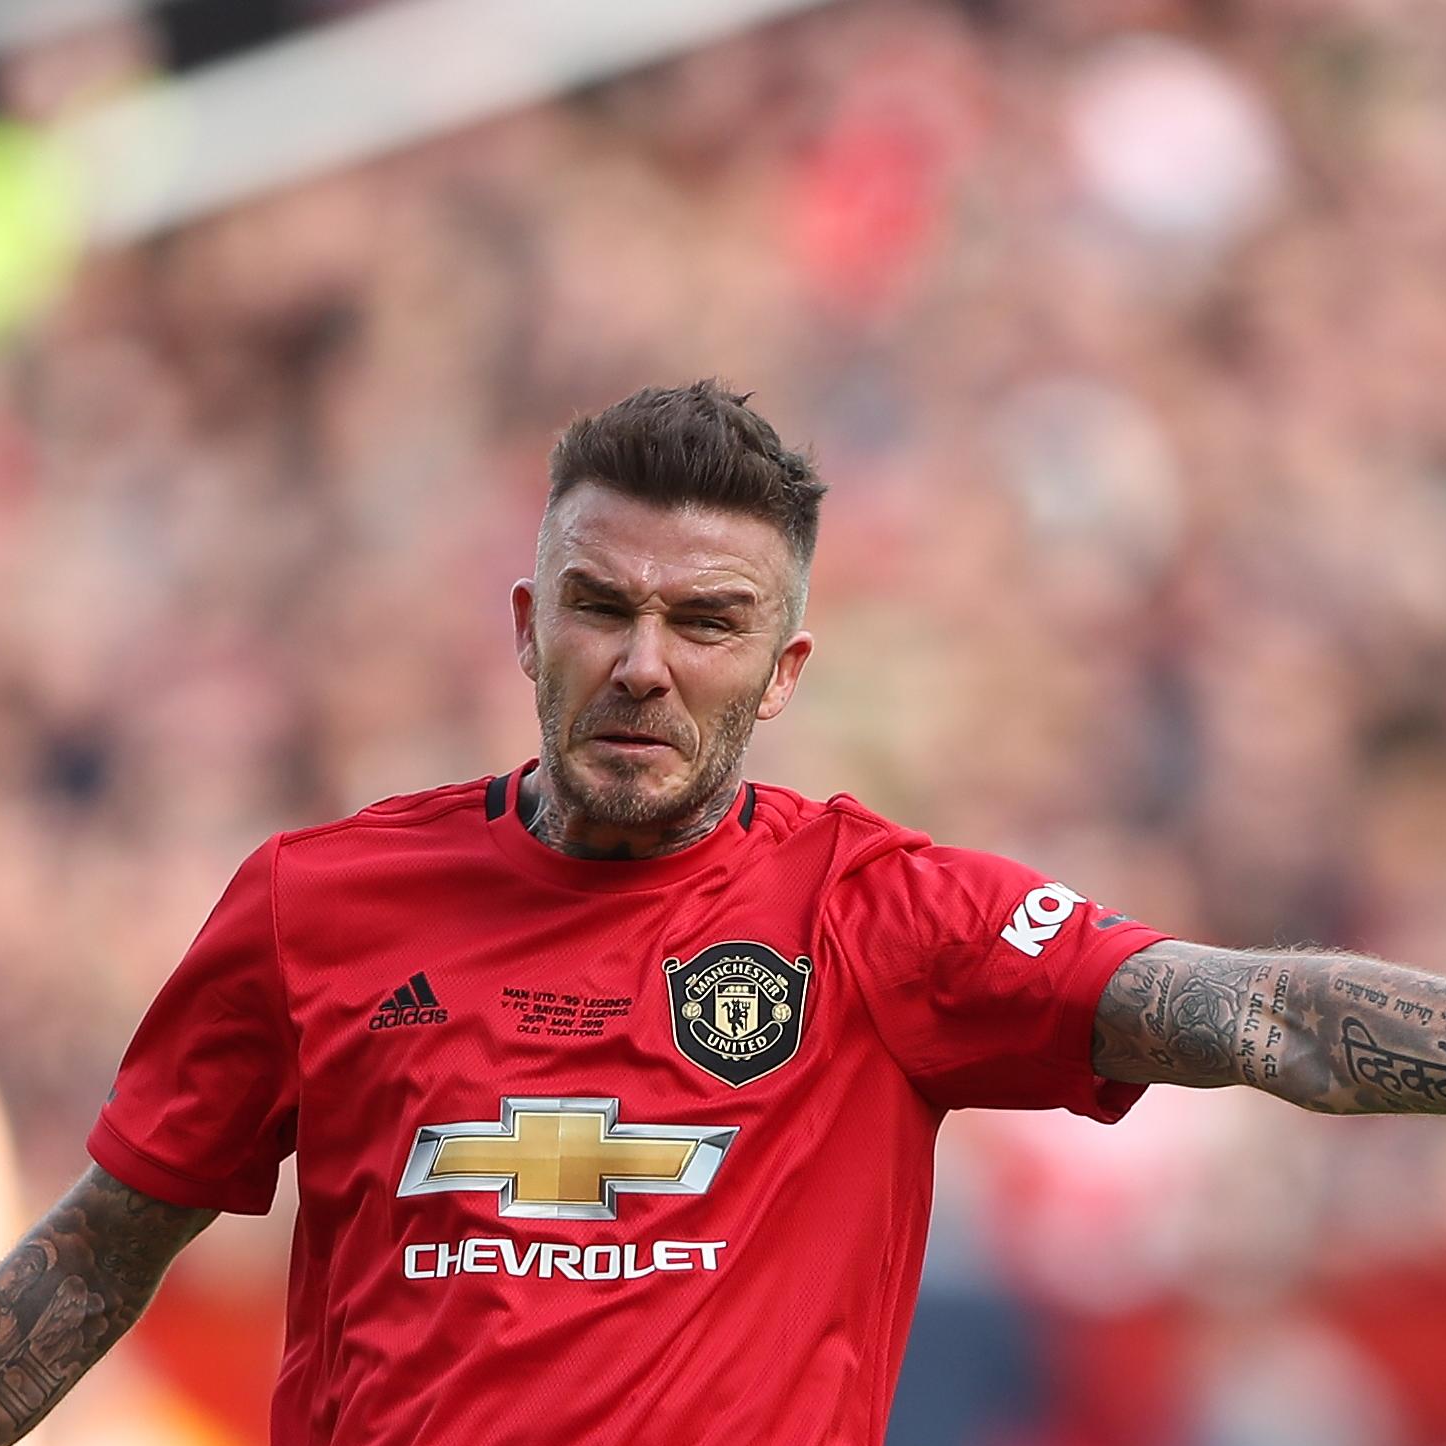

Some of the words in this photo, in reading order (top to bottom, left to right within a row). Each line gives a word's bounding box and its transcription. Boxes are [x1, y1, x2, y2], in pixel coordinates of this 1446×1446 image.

[693, 963, 780, 997] MANCHESTER
[503, 987, 529, 999] MAN
[534, 992, 556, 1003] UTD
[583, 997, 633, 1008] LEGENDS
[369, 1006, 448, 1030] adidas
[513, 1002, 529, 1012] FC
[533, 1003, 576, 1017] BAYERN
[580, 1008, 629, 1018] LEGENDS
[517, 1024, 540, 1034] OLD
[546, 1027, 603, 1037] TRAFFORD
[551, 1018, 573, 1027] MAY
[707, 1033, 767, 1053] UNITED
[404, 1238, 727, 1280] CHEVROLET
